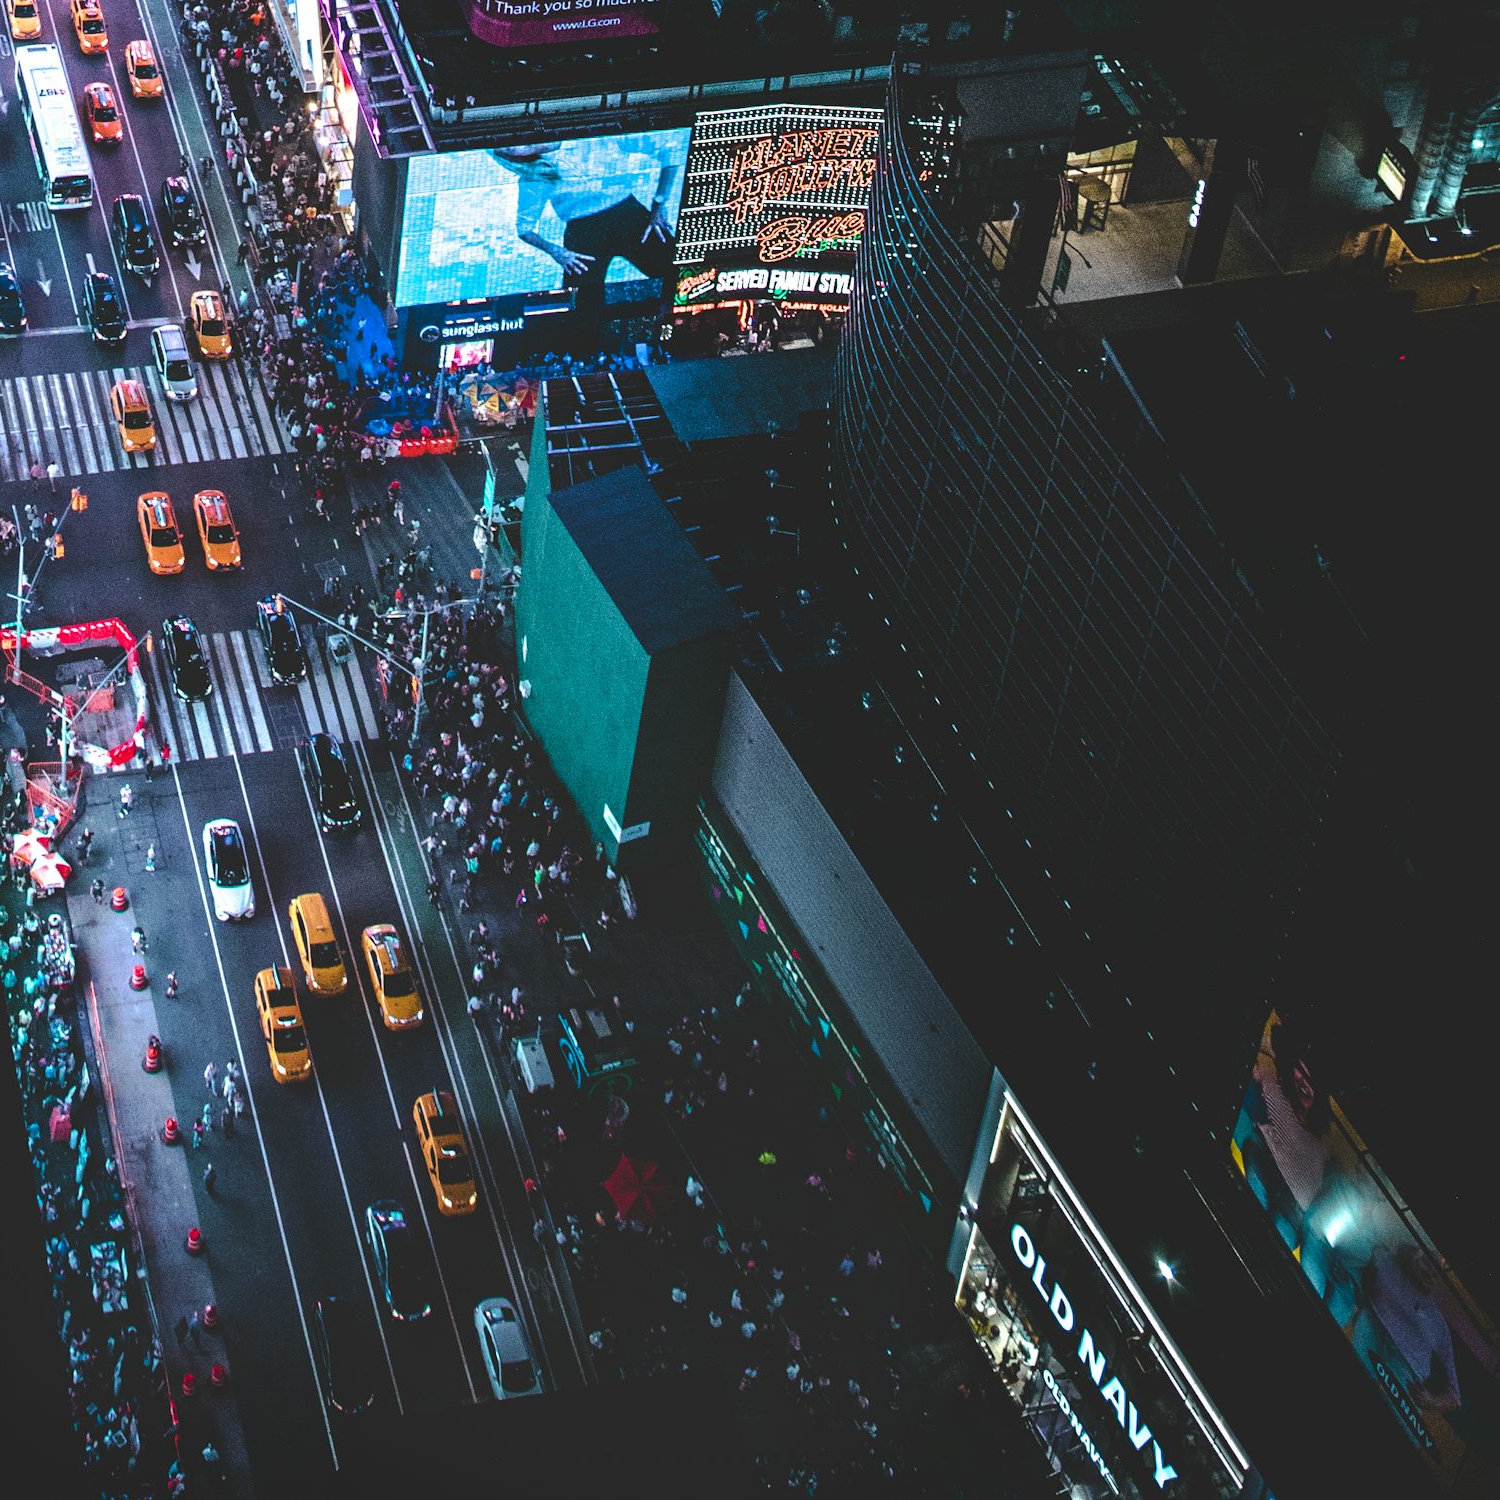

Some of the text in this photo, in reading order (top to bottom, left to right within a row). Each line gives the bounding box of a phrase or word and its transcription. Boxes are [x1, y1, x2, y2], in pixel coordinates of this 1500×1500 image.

[495, 0, 540, 15] Thank
[543, 0, 571, 16] you
[553, 17, 621, 31] www.LG.com
[730, 129, 878, 193] PLANET
[729, 158, 876, 224] HOLLYW
[716, 269, 769, 292] SERVED
[769, 270, 820, 292] FAMILY
[442, 316, 524, 339] sunglass hut
[781, 301, 851, 313] PLANET HOLLY
[1011, 1223, 1178, 1489] OLD NAVY
[1043, 1368, 1111, 1477] OLD NAVY
[1376, 1362, 1433, 1448] OLD NAVY
